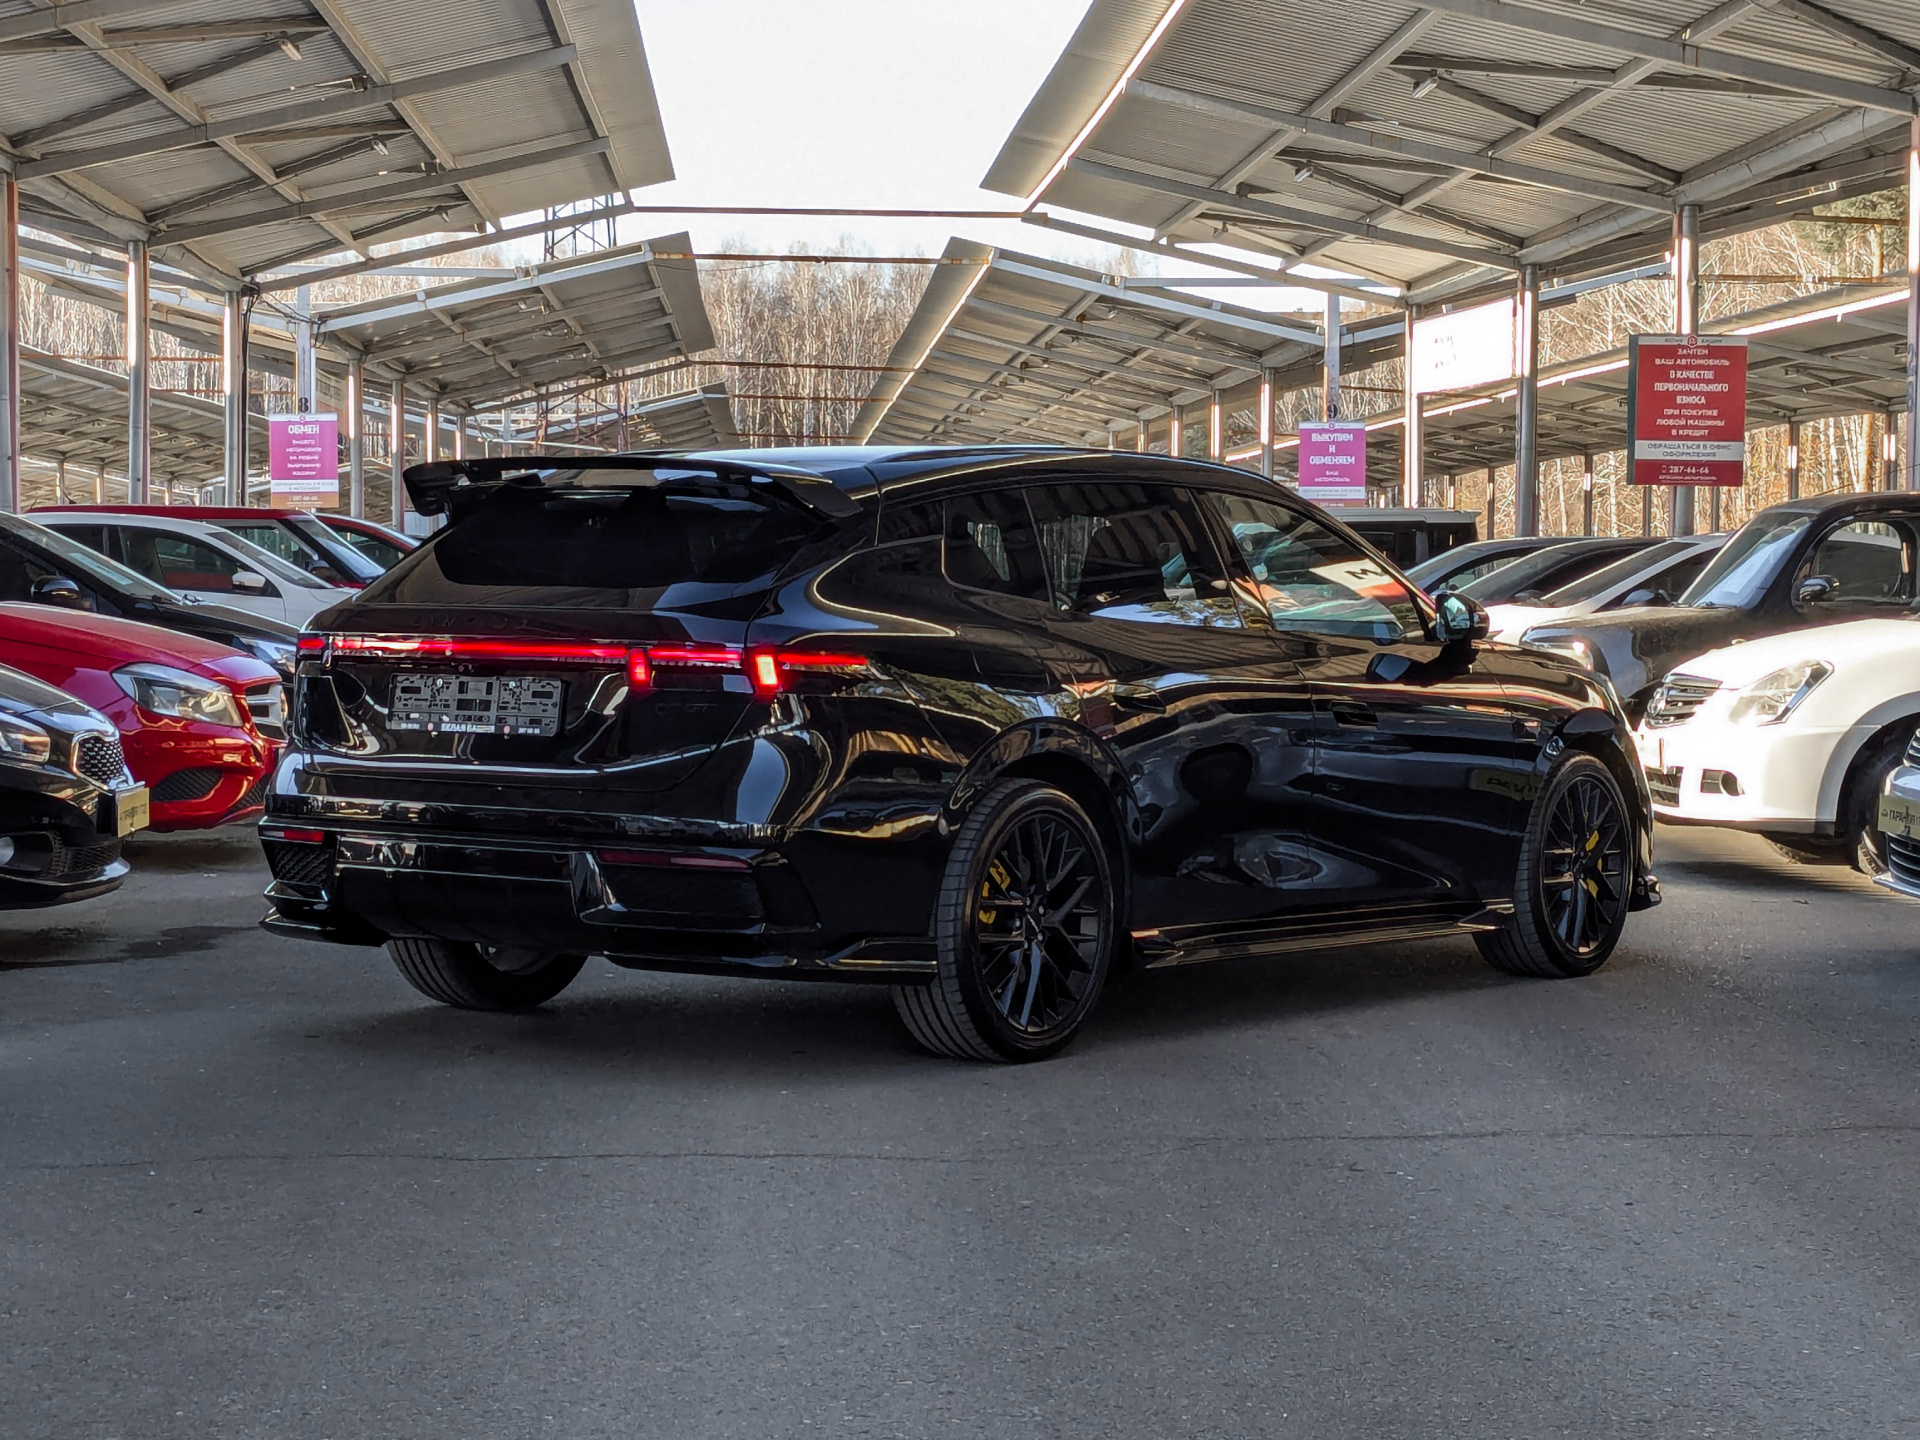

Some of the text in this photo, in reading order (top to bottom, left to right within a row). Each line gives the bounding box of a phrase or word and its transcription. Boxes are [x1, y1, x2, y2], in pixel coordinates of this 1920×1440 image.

[1675, 358, 1730, 366] АВТОМОБИЛЬ
[1669, 370, 1715, 379] В КАЧЕСТВЕ
[1654, 382, 1729, 392] ПЕРВОНАЧАЛЬНОГО
[1676, 395, 1706, 404] ВЗНОСА
[1663, 408, 1718, 416] ПРИ ПОКУПКЕ
[1656, 418, 1725, 427] ЛЮБОЙ МАШИНЫ
[1678, 429, 1709, 437] КРЕДИТ
